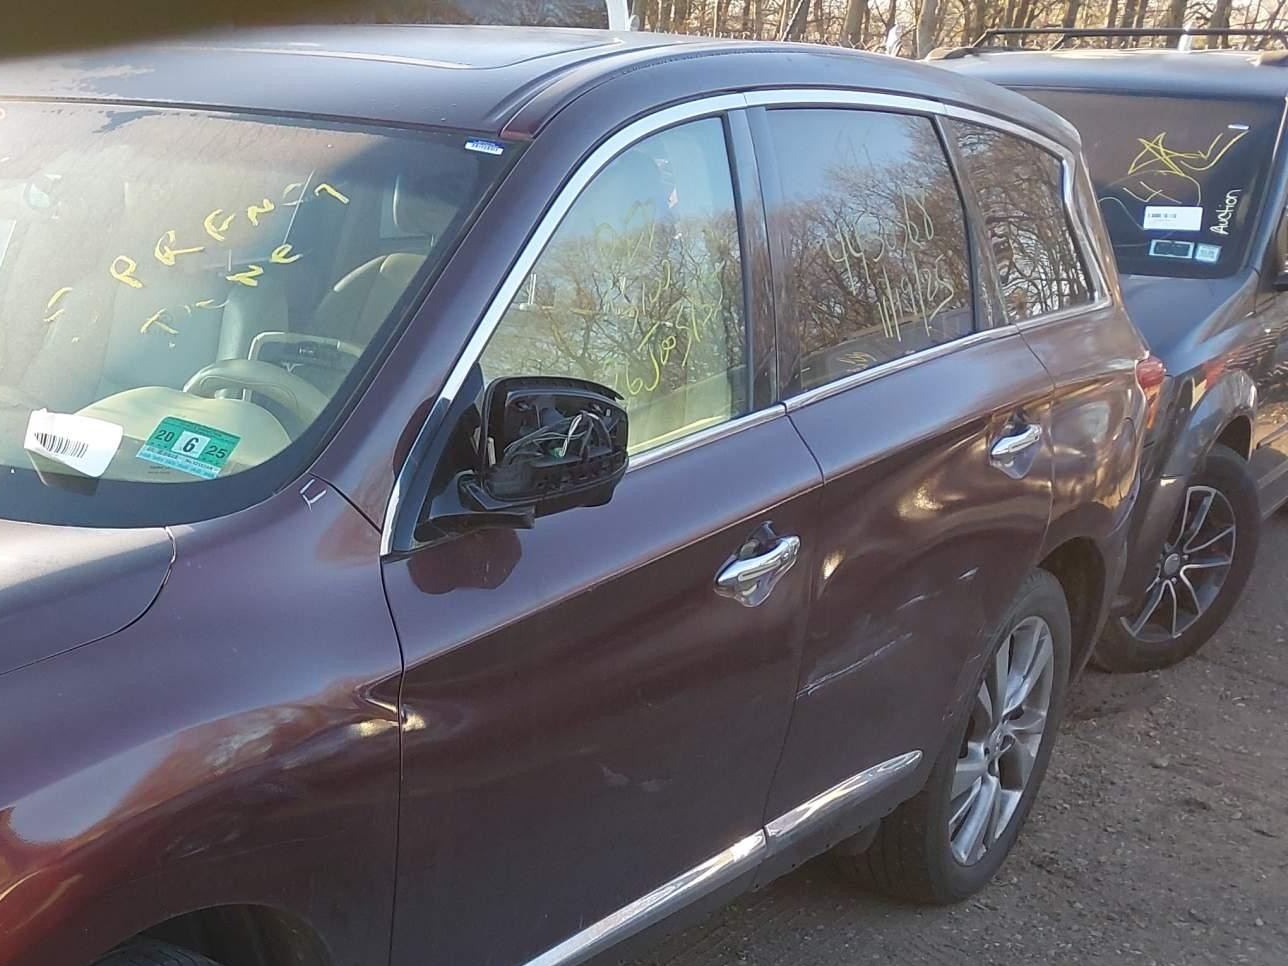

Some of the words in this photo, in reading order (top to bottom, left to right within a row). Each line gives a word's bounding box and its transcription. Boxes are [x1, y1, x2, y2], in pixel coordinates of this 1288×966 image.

[1209, 188, 1242, 236] Auction
[154, 429, 176, 443] 20
[182, 437, 200, 453] 6
[205, 445, 229, 459] 25
